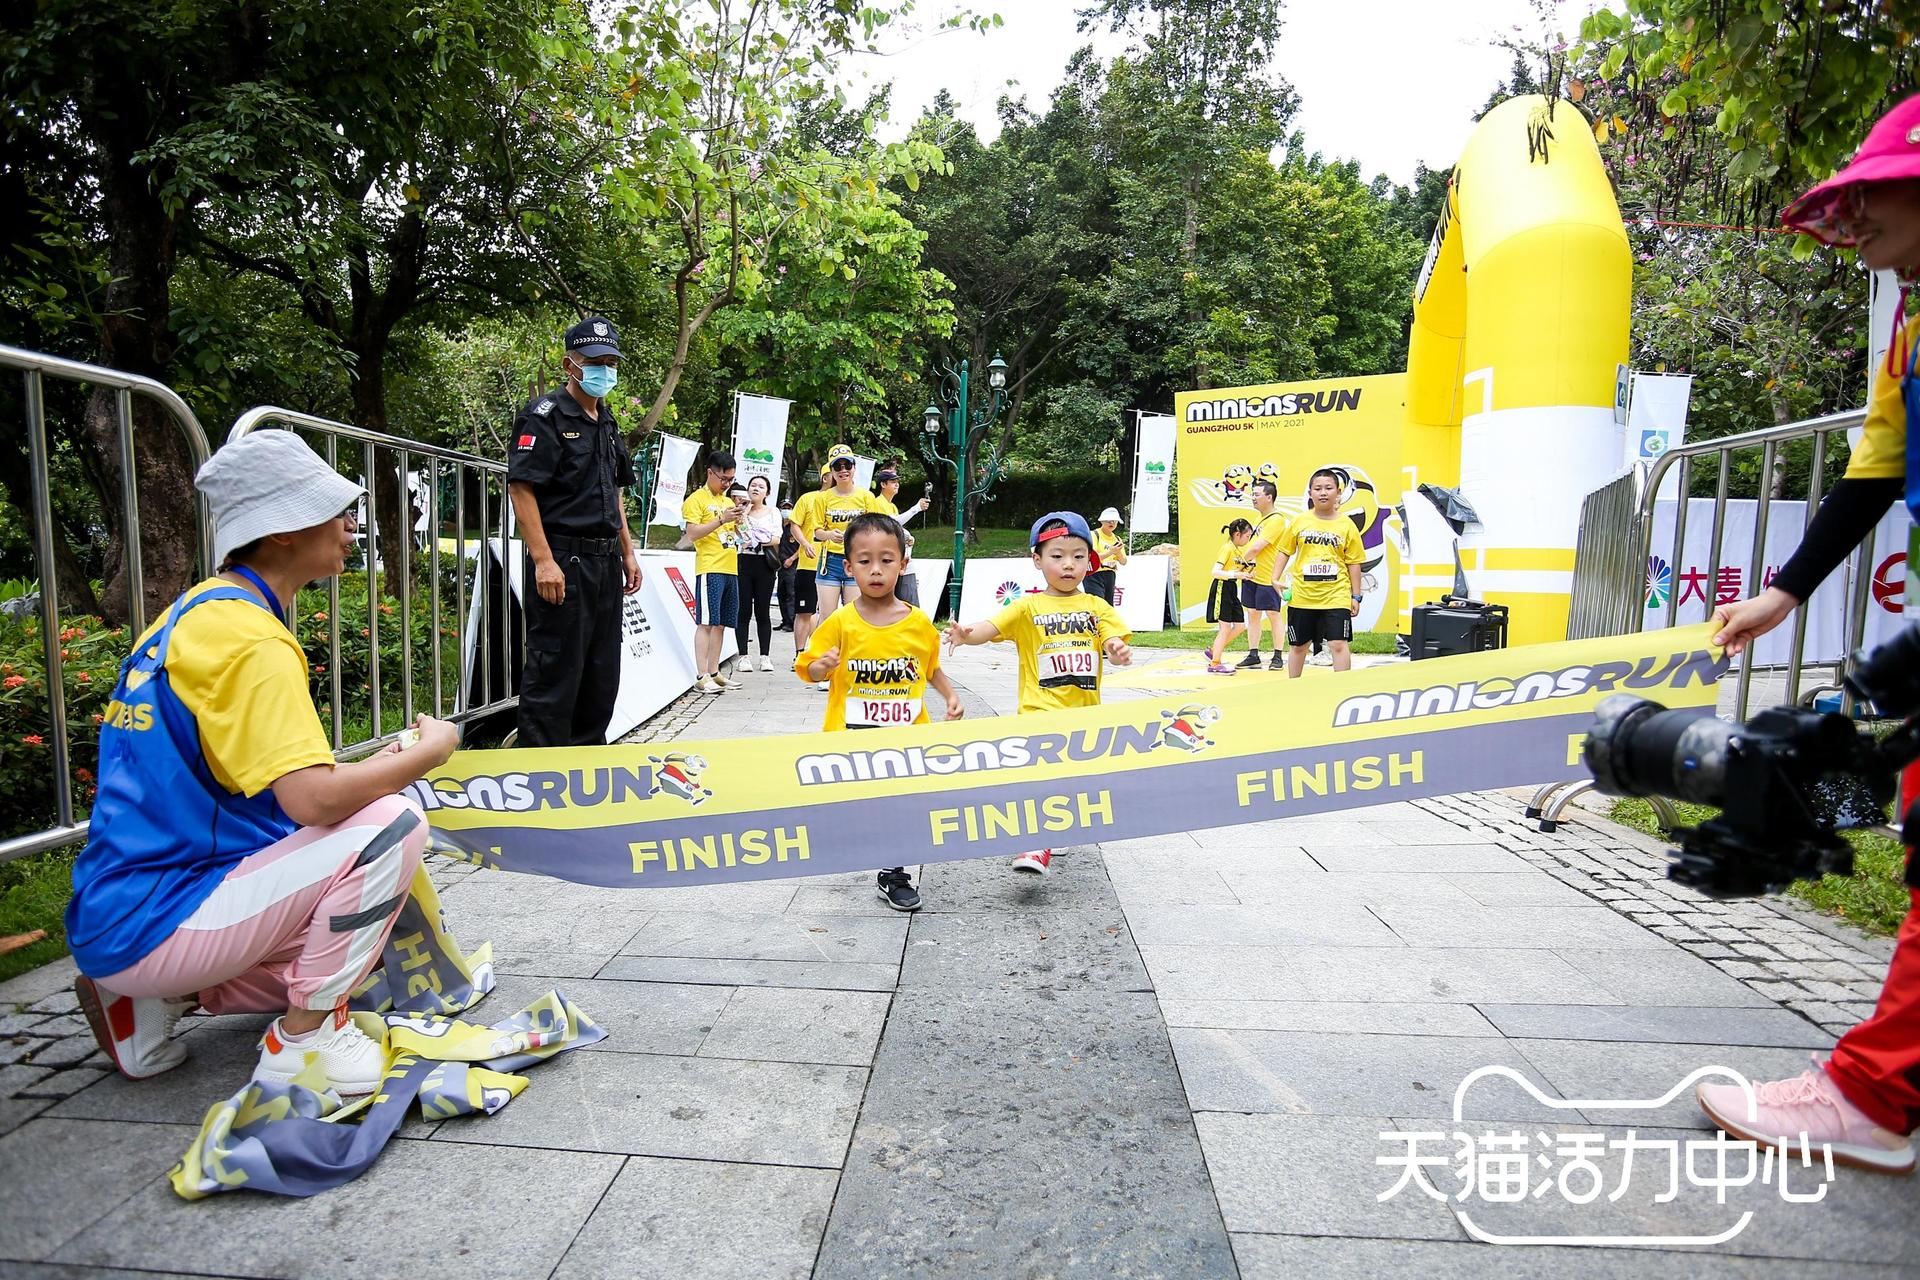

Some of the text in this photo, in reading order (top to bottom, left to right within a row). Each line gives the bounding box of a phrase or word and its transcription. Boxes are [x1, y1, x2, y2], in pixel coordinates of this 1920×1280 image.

[1186, 419, 1304, 434] GUANGZHOU 5K MAY 2021
[1304, 535, 1330, 546] RUN
[1044, 620, 1085, 637] RUN
[1050, 652, 1092, 674] 10129
[855, 670, 902, 685] RUN
[863, 701, 911, 722] 12505
[1236, 751, 1424, 807] FINISH
[928, 790, 1114, 846] FINISH
[628, 825, 811, 874] FINISH
